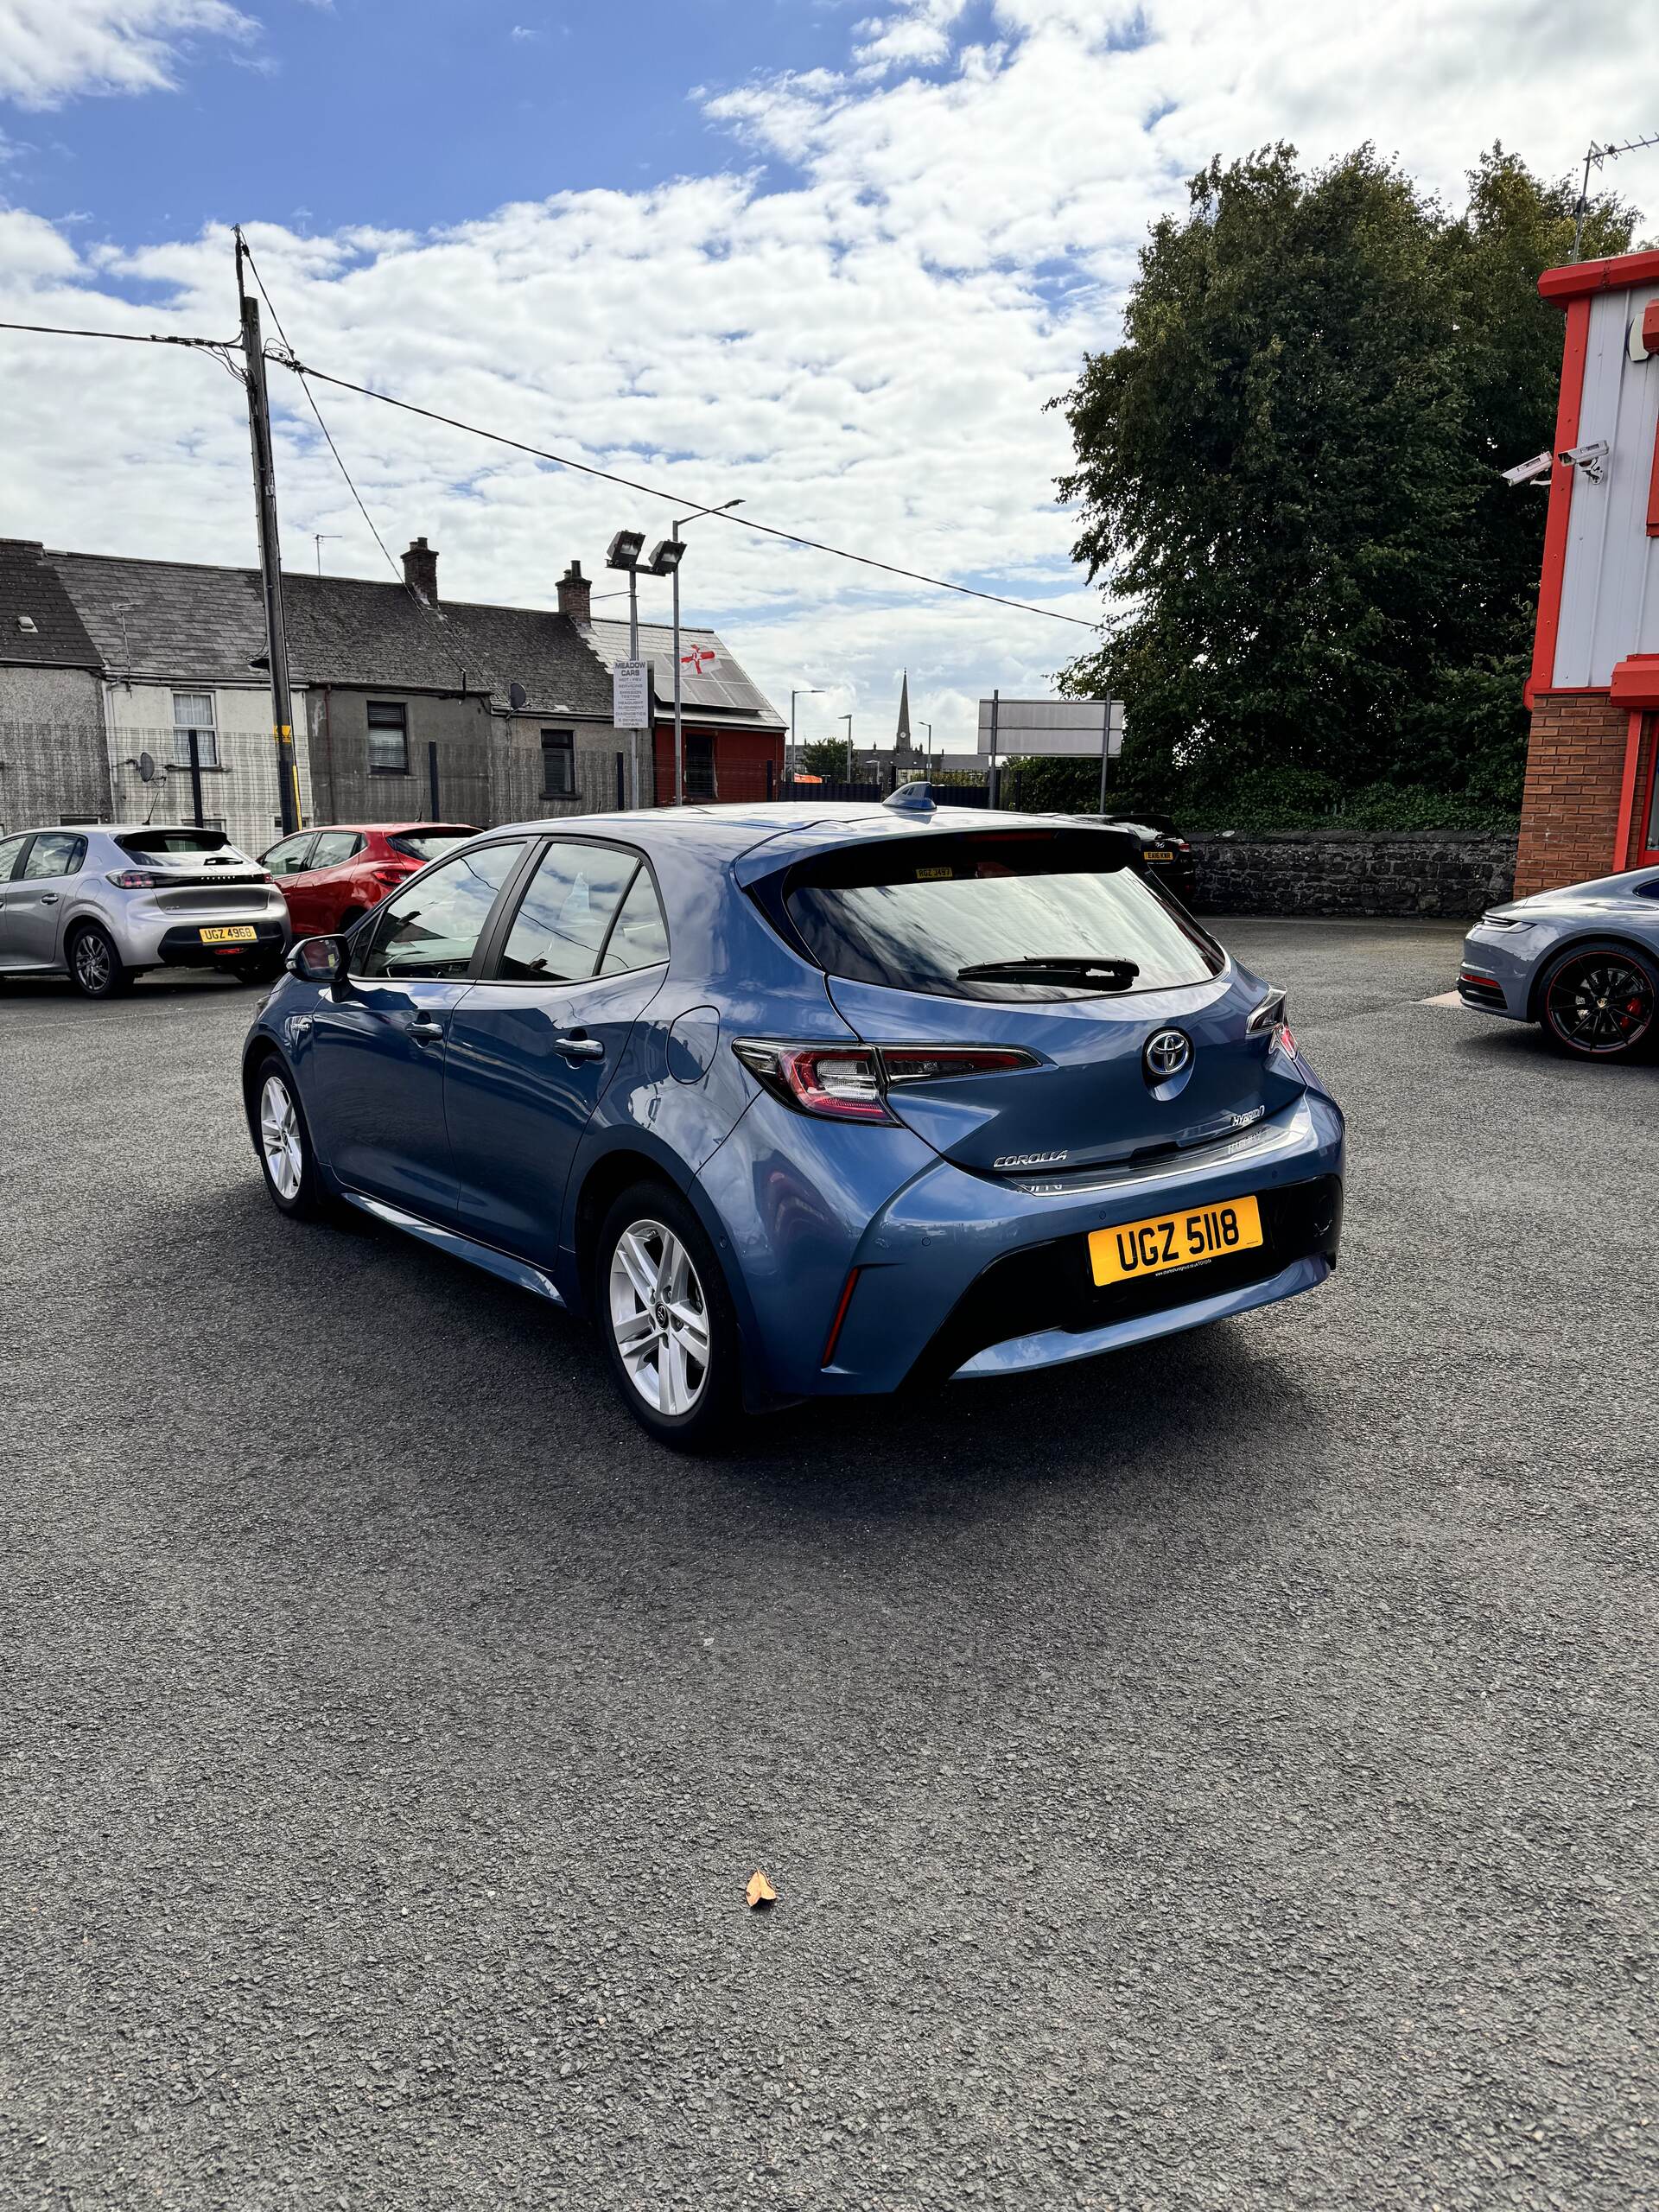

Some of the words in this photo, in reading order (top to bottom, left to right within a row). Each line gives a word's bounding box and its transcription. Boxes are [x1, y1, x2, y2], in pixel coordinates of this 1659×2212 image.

[204, 929, 226, 940] UGZ
[993, 1149, 1069, 1168] COROLLA
[1116, 1221, 1179, 1272] UGZ
[1185, 1208, 1240, 1255] 5118
